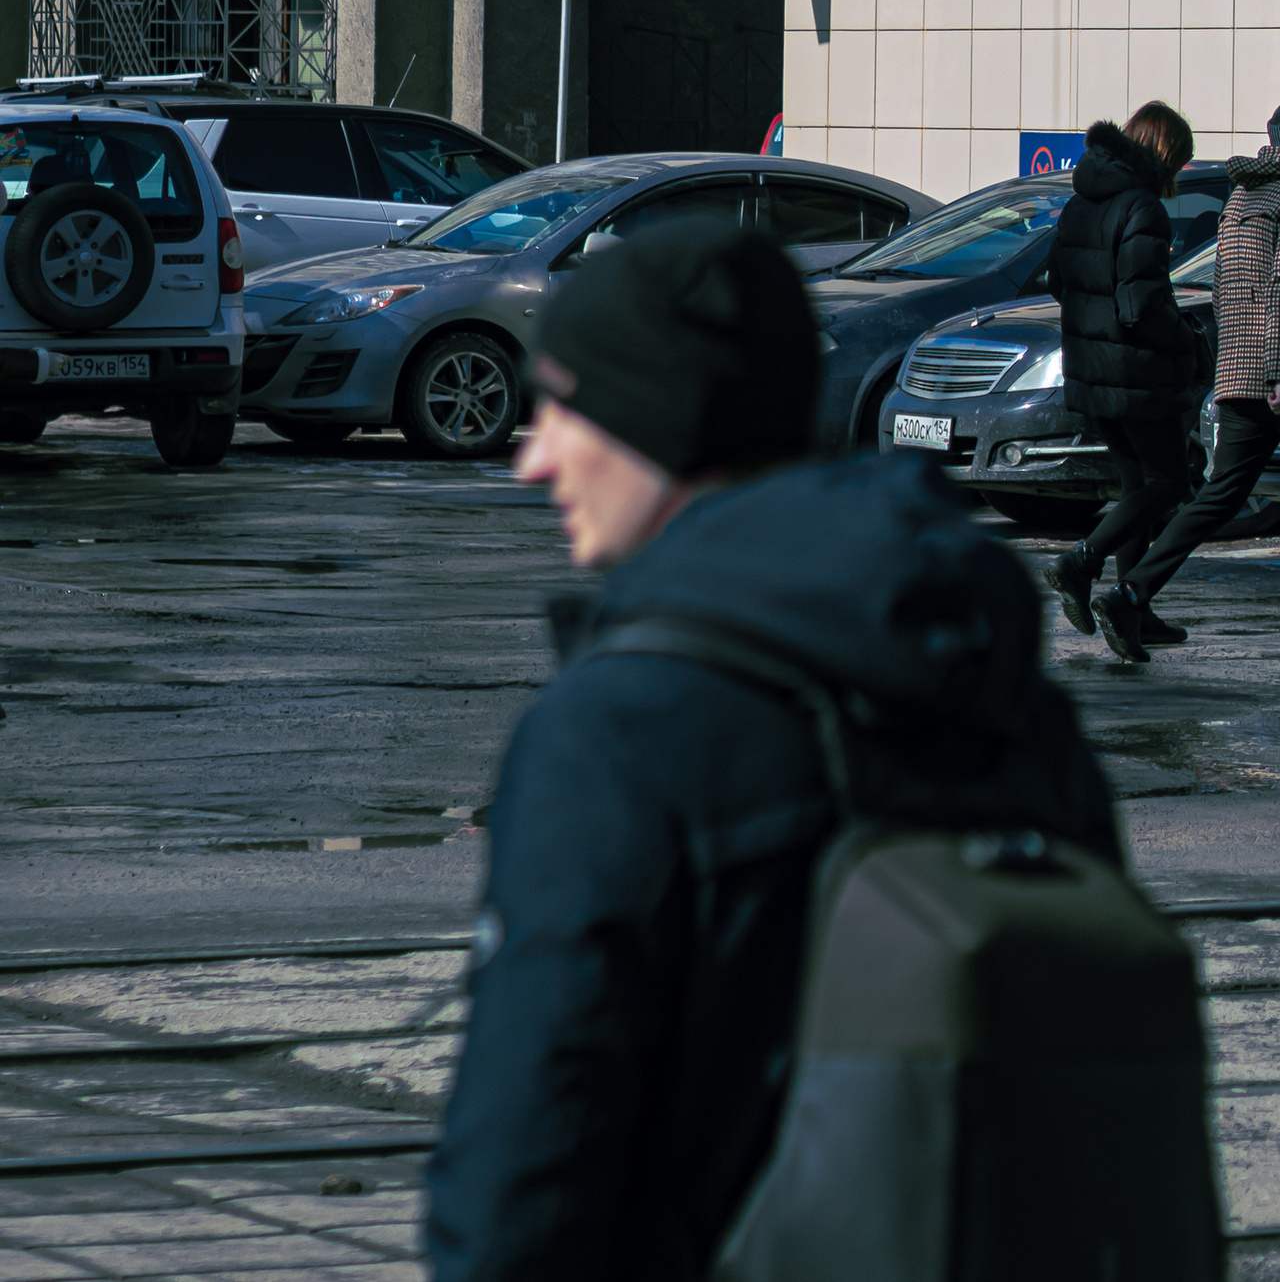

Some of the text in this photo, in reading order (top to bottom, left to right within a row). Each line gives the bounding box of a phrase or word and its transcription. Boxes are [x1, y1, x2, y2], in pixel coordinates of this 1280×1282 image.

[60, 356, 146, 376] 059КВ 154
[934, 420, 949, 436] 154
